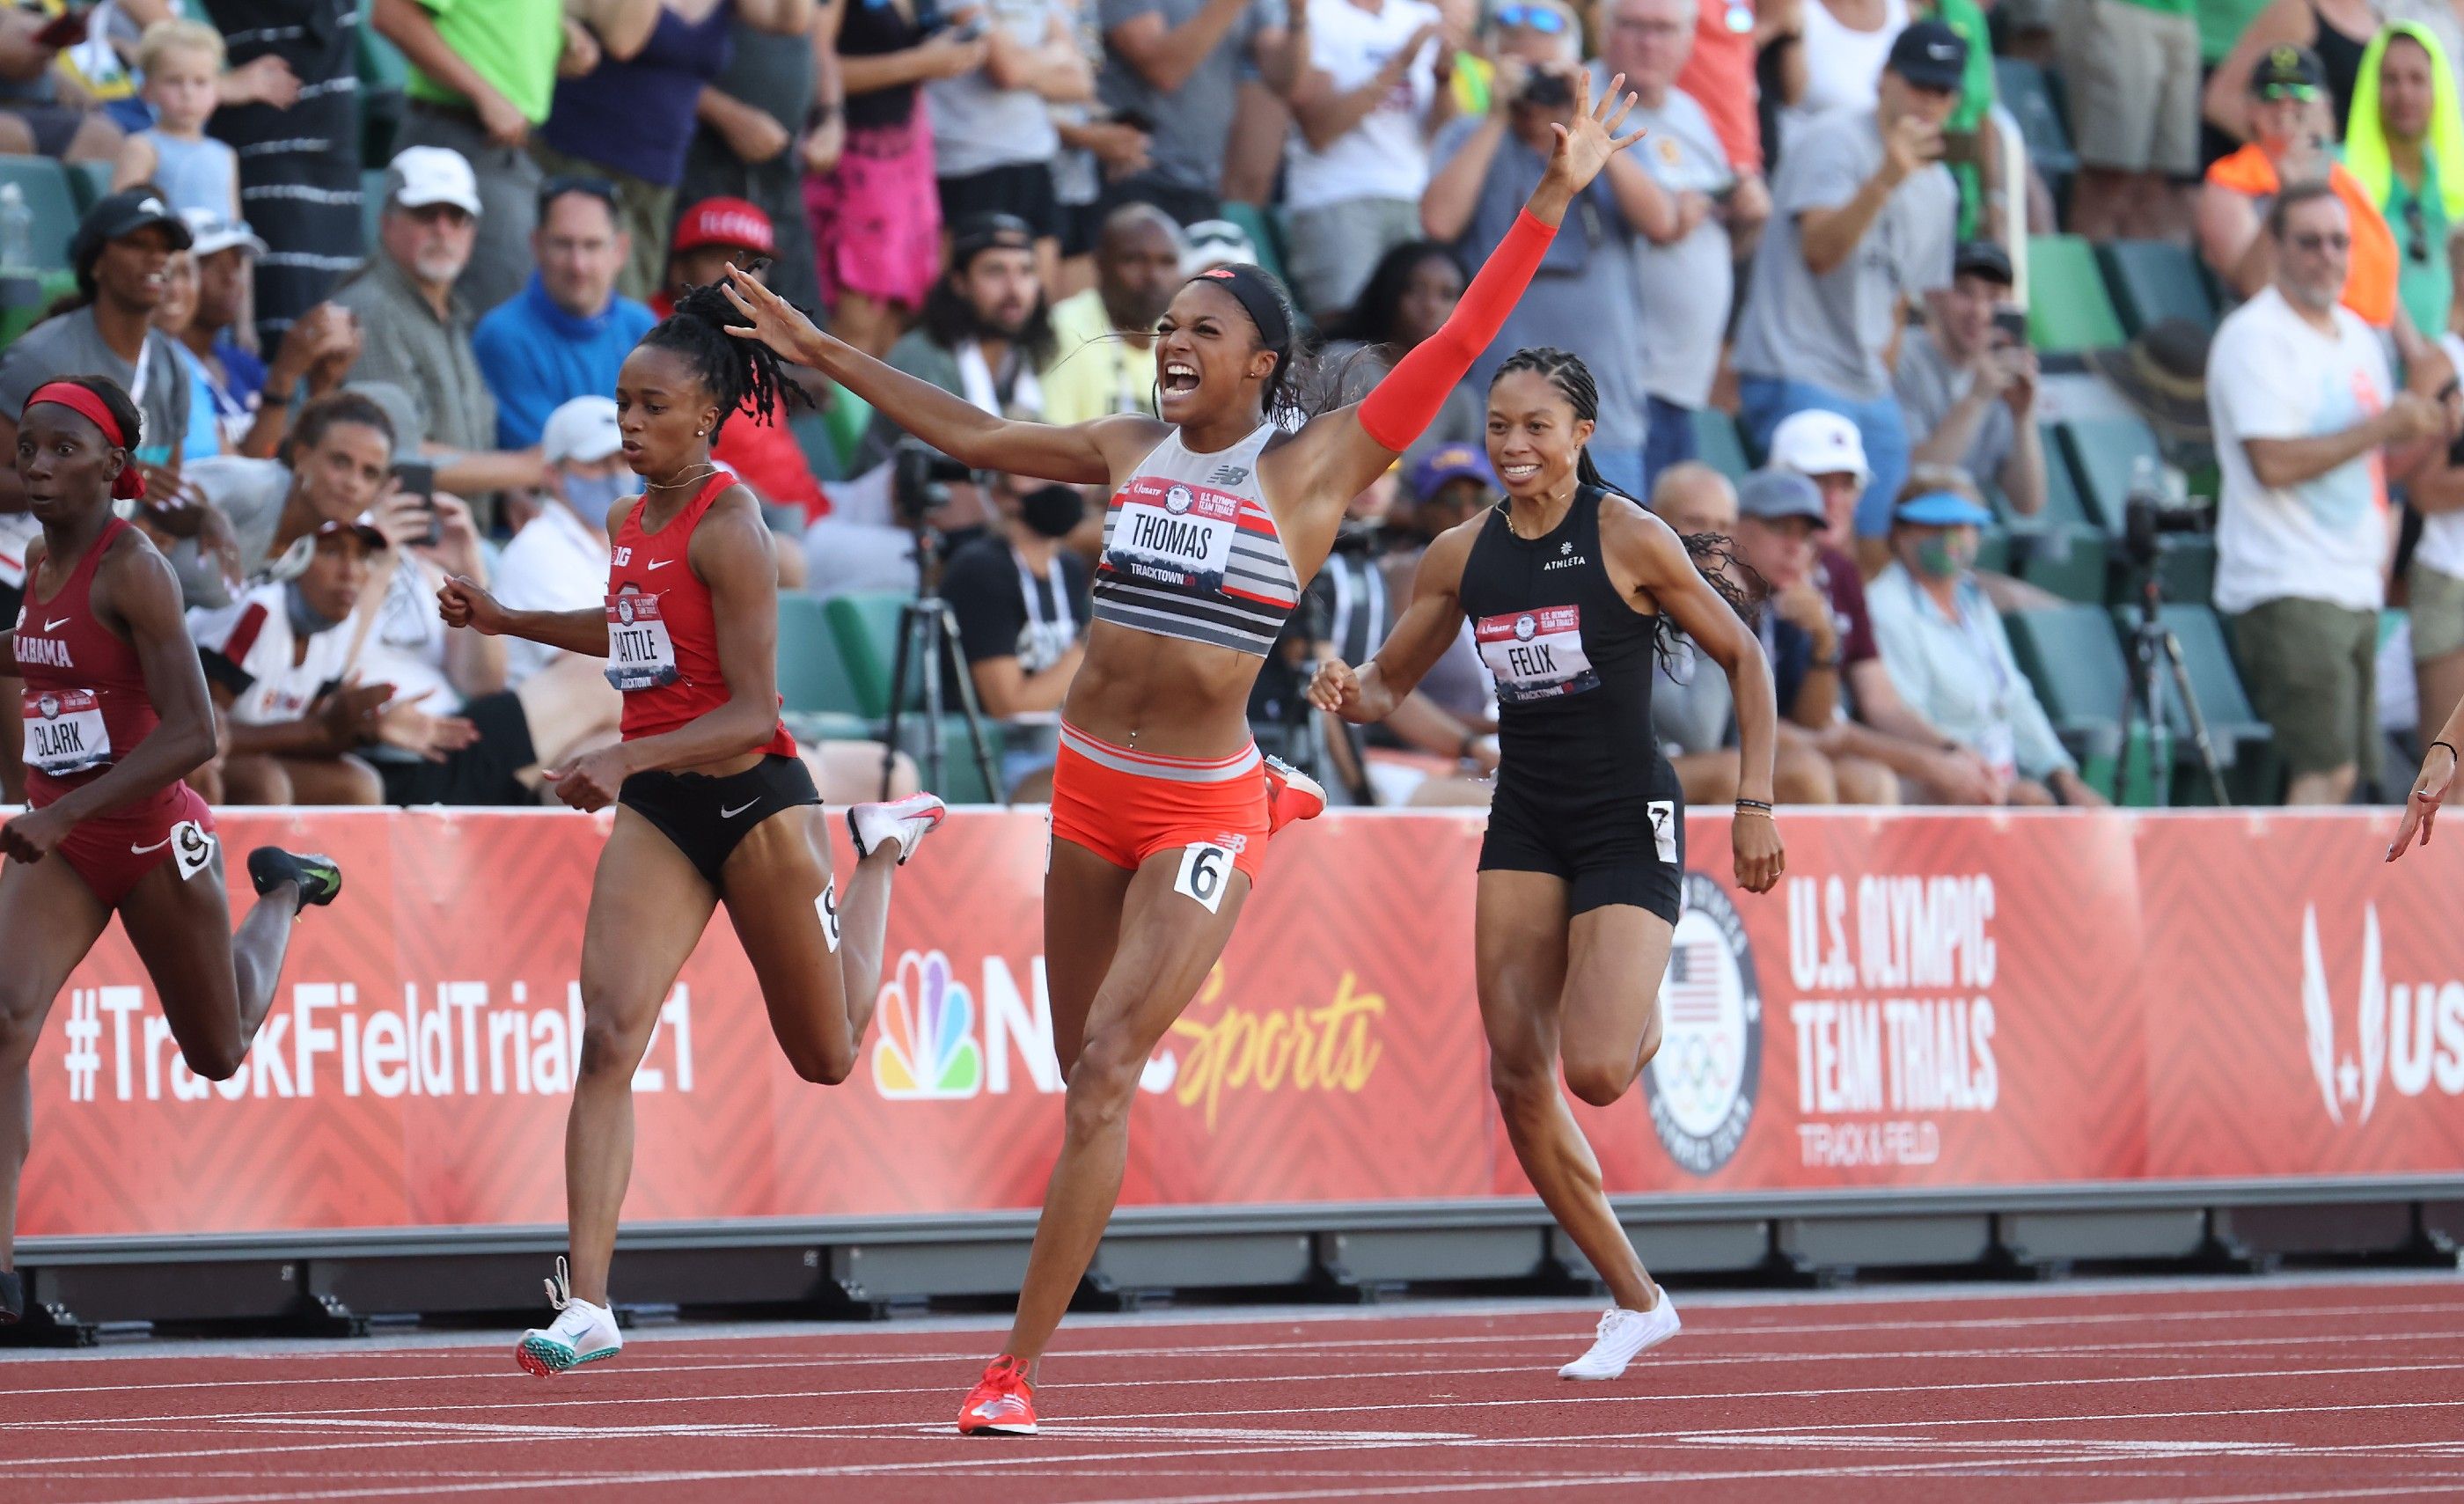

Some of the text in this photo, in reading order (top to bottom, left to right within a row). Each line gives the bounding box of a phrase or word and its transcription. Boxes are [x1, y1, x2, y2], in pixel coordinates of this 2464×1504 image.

[1198, 501, 1214, 511] TEAM
[1214, 503, 1234, 516] TRIALS
[1132, 513, 1213, 560] THOMAS
[1544, 556, 1586, 570] ATHLETA
[1507, 643, 1558, 677] FELIX
[33, 721, 85, 757] CLARK
[1651, 807, 1669, 832] 7
[180, 825, 208, 867] 9
[1191, 847, 1224, 900] 6
[1788, 874, 1997, 991] U.S. OLYMPIC
[1171, 957, 1385, 1134] Sports
[1791, 994, 1998, 1113] TEAM TRIALS
